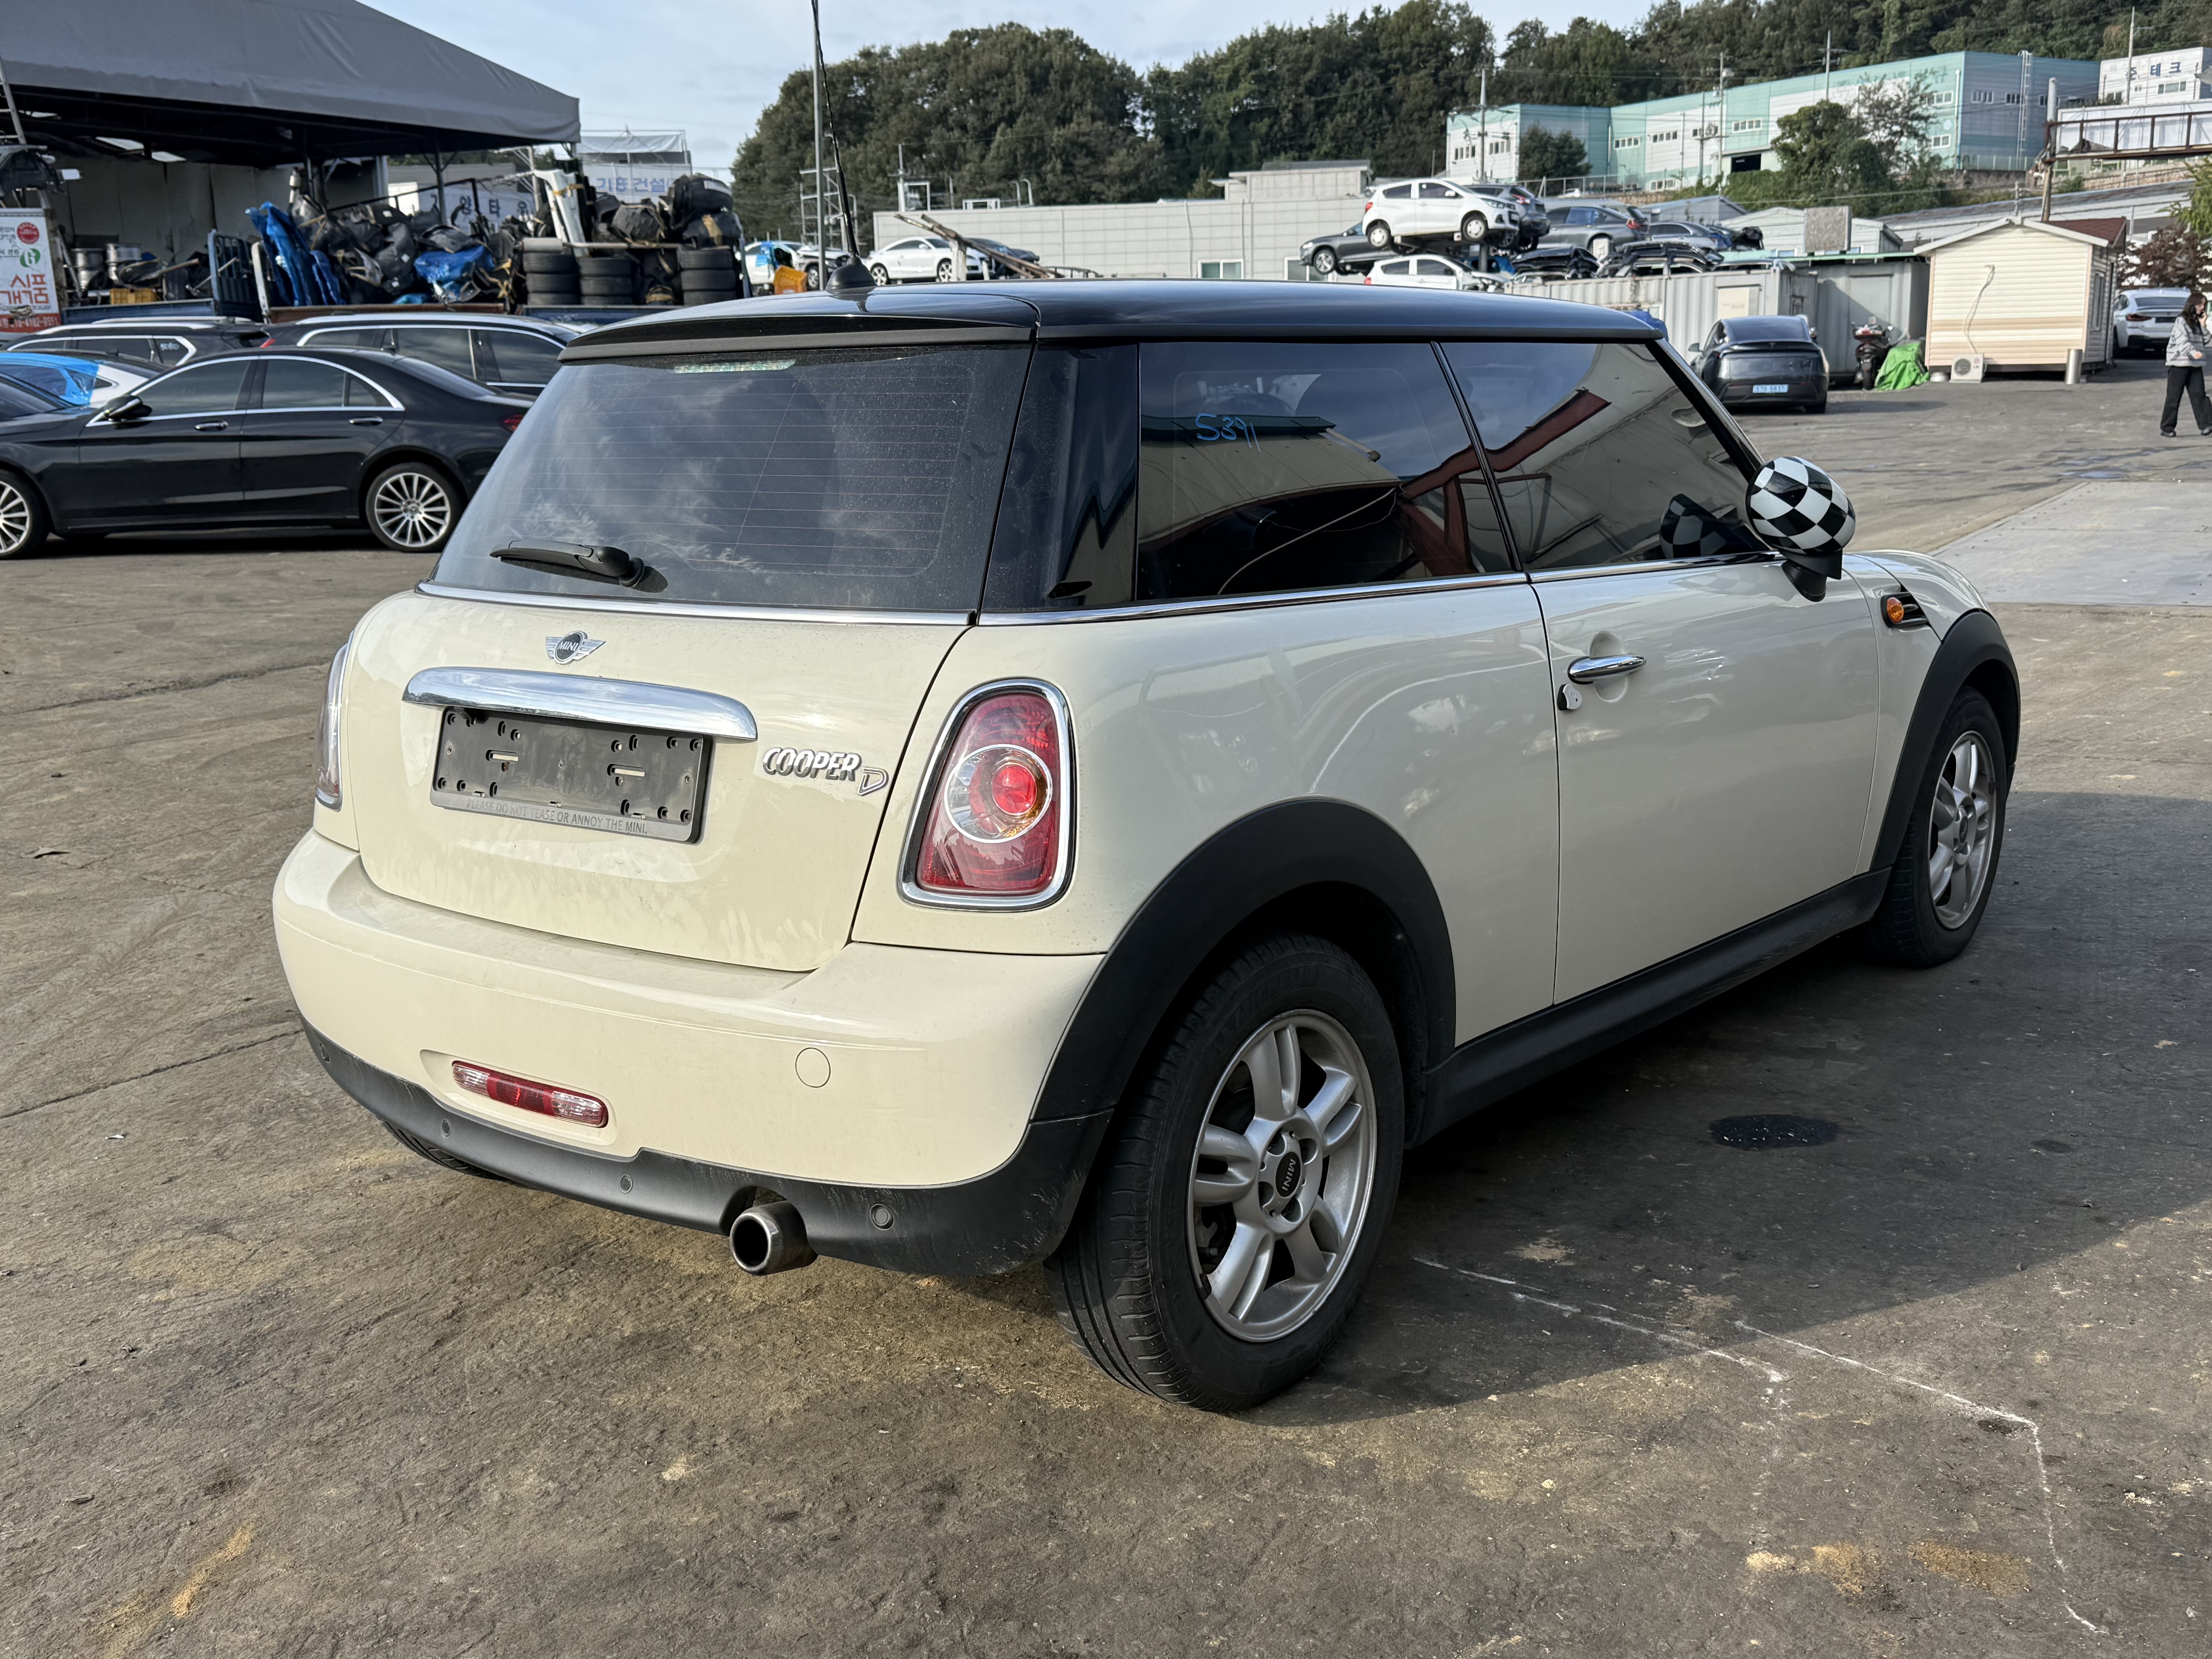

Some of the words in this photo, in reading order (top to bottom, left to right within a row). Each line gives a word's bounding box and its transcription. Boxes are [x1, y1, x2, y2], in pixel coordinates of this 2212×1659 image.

[558, 641, 579, 651] MINI
[763, 747, 862, 781] COOPER
[857, 767, 889, 796] D
[467, 799, 494, 811] PLEASE
[496, 802, 508, 815] DO
[510, 805, 527, 817] NOT
[530, 807, 555, 821] TEASE
[557, 812, 569, 823] OR
[571, 814, 603, 827] ANNOY
[606, 818, 623, 830] THE
[625, 821, 647, 834] MINI.
[1282, 1159, 1296, 1191] MINI
